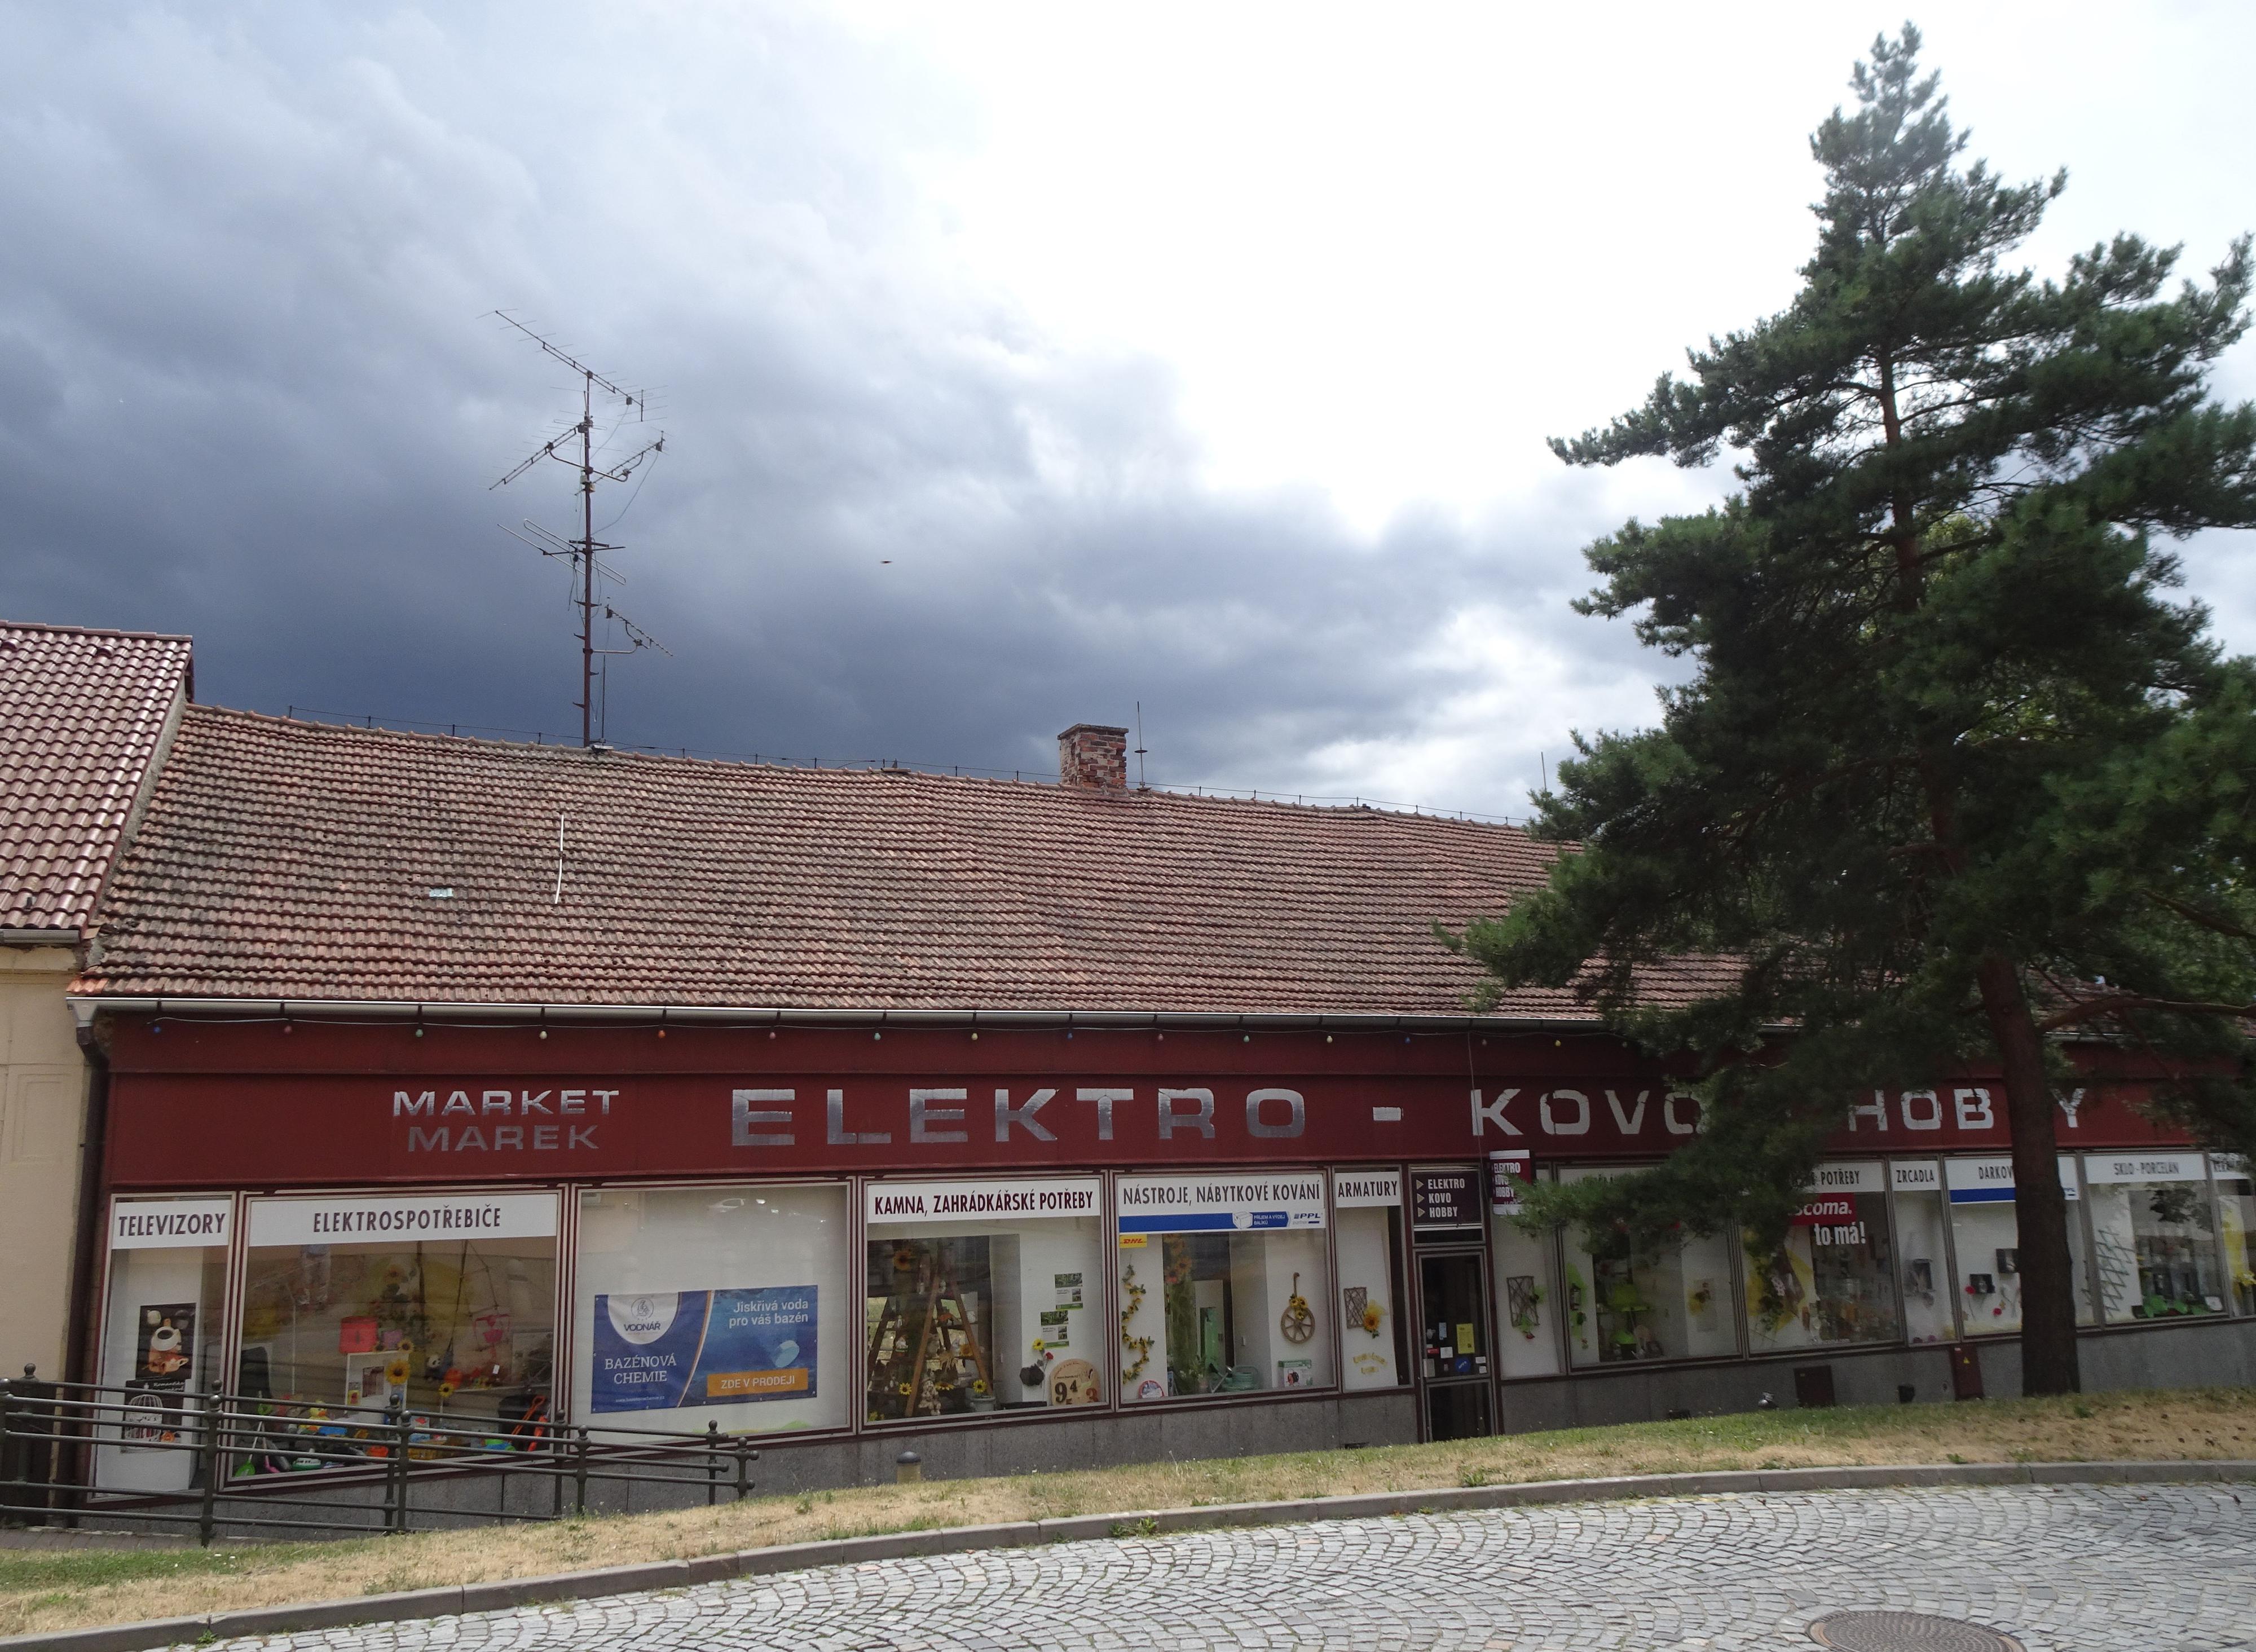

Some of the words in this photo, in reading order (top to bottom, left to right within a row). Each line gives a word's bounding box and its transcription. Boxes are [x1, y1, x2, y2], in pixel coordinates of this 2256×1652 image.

[393, 1090, 619, 1116] MARKET
[732, 1087, 1305, 1146] ELEKTRO
[1470, 1088, 1708, 1136] KOVO
[1848, 1087, 2087, 1131] HOBY
[408, 1125, 600, 1152] MAREK
[1494, 1162, 1521, 1174] ELEKTRO
[1896, 1169, 1935, 1183] ZRCADLA
[1427, 1178, 1466, 1190] ELEKTRO
[1821, 1169, 1860, 1185] POTŘEBY
[1123, 1183, 1192, 1206] NÁSTROJE,
[1196, 1181, 1269, 1202] NÁBYTKOVÉ
[1272, 1179, 1320, 1201] KOVÁNÍ
[1338, 1180, 1398, 1198] ARMATURY
[875, 1195, 928, 1217] KAMNA,
[933, 1188, 1036, 1213] ZAHRÁDKÁŘSKÉ
[1039, 1187, 1094, 1210] POTŘEBY
[1428, 1192, 1452, 1204] KOVO
[313, 1204, 501, 1233] ELEKTROSPOTŘEBIČE
[1429, 1206, 1459, 1218] HOBBY
[118, 1213, 226, 1237] TELEVIZORY
[1813, 1223, 1831, 1246] to
[1834, 1221, 1866, 1245] má!
[782, 1298, 809, 1309] voda
[623, 1321, 661, 1331] VODNÁŘ
[729, 1317, 748, 1329] pro
[751, 1314, 772, 1325] váš
[774, 1312, 809, 1324] bazén
[605, 1353, 677, 1370] BAZÉNOVÁ
[614, 1371, 668, 1385] CHEMIE
[721, 1379, 741, 1389] ZDE
[743, 1378, 751, 1387] V
[752, 1376, 795, 1387] PRODEJI
[1069, 1380, 1078, 1393] 4
[1055, 1382, 1067, 1403] 9
